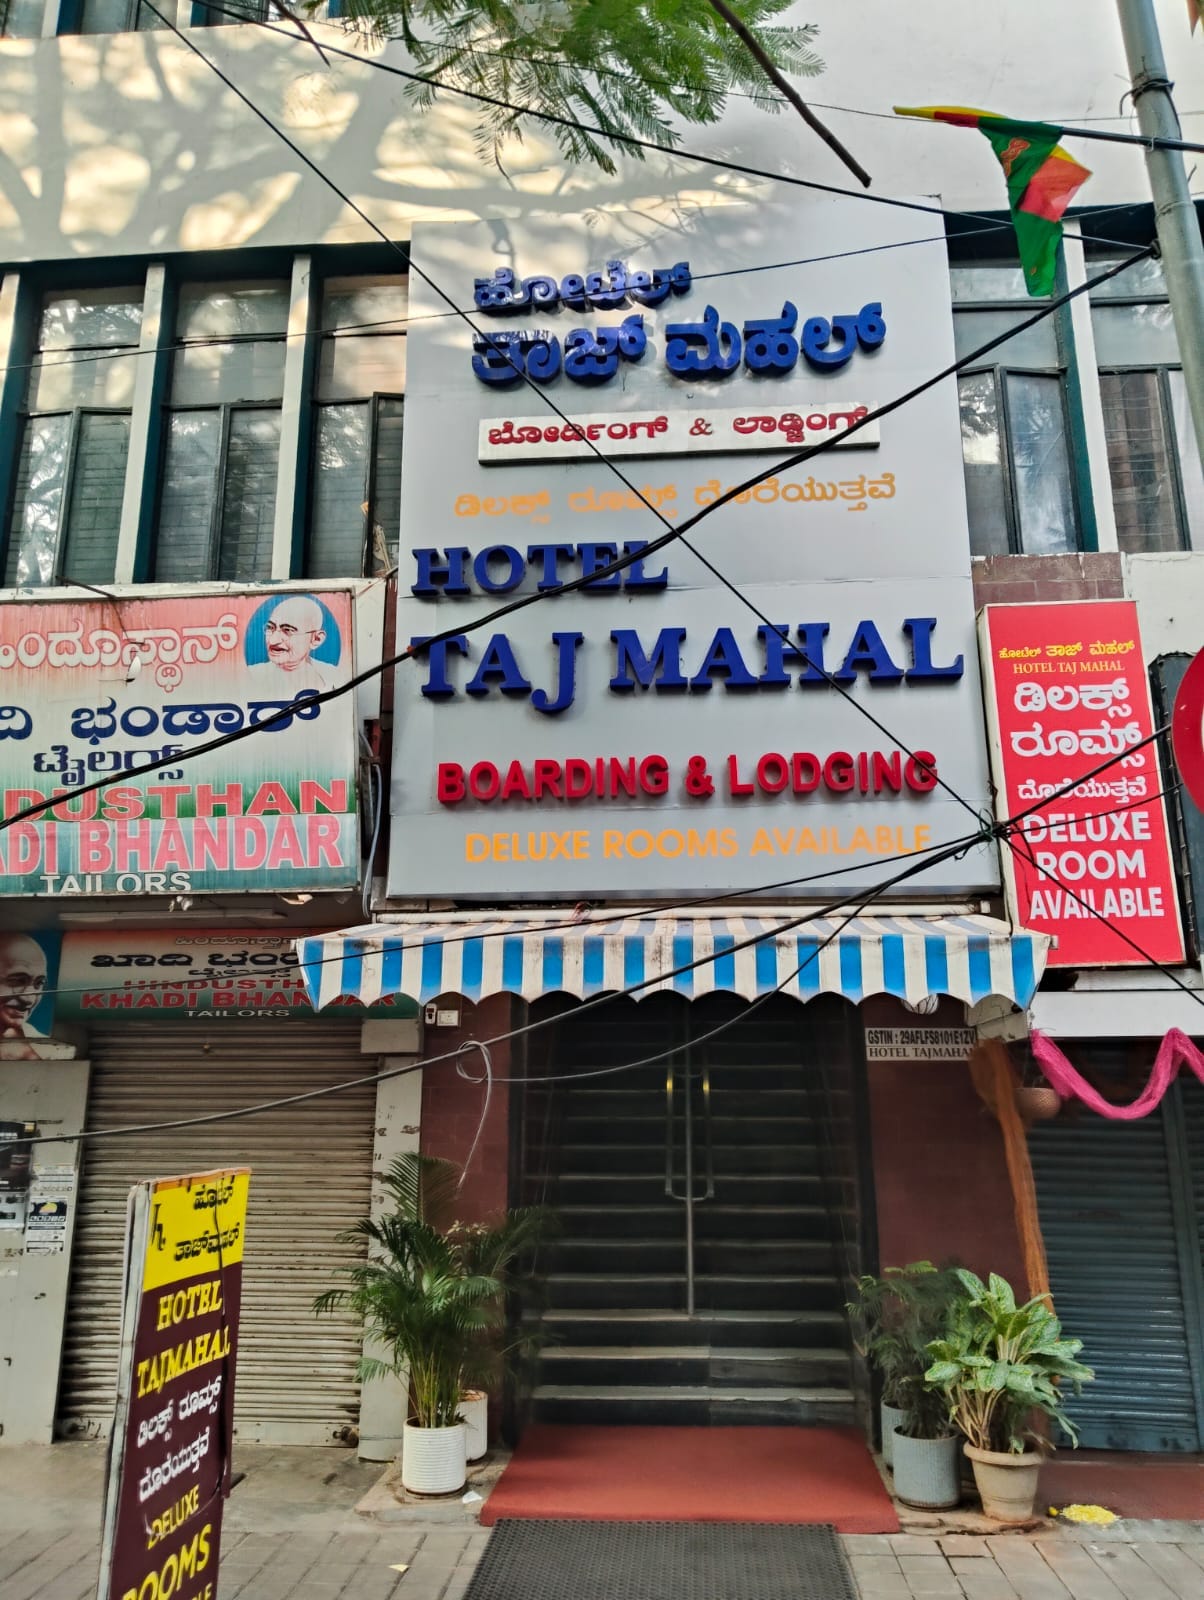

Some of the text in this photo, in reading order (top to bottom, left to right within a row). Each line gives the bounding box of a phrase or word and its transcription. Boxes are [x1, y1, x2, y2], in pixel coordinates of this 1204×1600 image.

[474, 260, 690, 314] ಹೋಟೆಲ್
[471, 301, 886, 385] ತಾಜ್ ಮಹಲ್
[689, 418, 713, 436] &
[411, 540, 668, 596] HOTEL
[410, 617, 964, 714] TAJ MAHAL
[1013, 660, 1125, 675] HOTEL TAJ MAHAL
[1046, 642, 1082, 657] ತಾಜ್
[1089, 640, 1135, 656] ಮಹಲ್
[71, 689, 320, 745] ಭಂಡಾರ್
[1014, 677, 1132, 718] ಡಿಲಕ್ಸ್
[1010, 720, 1145, 768] ರೂಮ್ಸ್
[437, 750, 938, 804] BOARDING & LODGING
[78, 815, 344, 874] BHANDAR
[465, 824, 930, 864] DELUXE ROOMS AVAILABLE
[1023, 811, 1152, 843] DELUXE
[1036, 849, 1146, 881] ROOM
[1030, 886, 1165, 920] AVAILABLE
[82, 991, 197, 1008] KHADI
[124, 979, 304, 990] HINDUSTH
[868, 1030, 893, 1045] GSTIN
[900, 1030, 975, 1045] 29AFLFS8101E1ZV
[869, 1047, 973, 1059] HOTEL TAJMAHA
[157, 1280, 223, 1331] HOTEL
[137, 1325, 231, 1398] TAJMAHAL
[147, 1485, 199, 1550] DELUXE
[122, 1524, 212, 1600] OOMS
